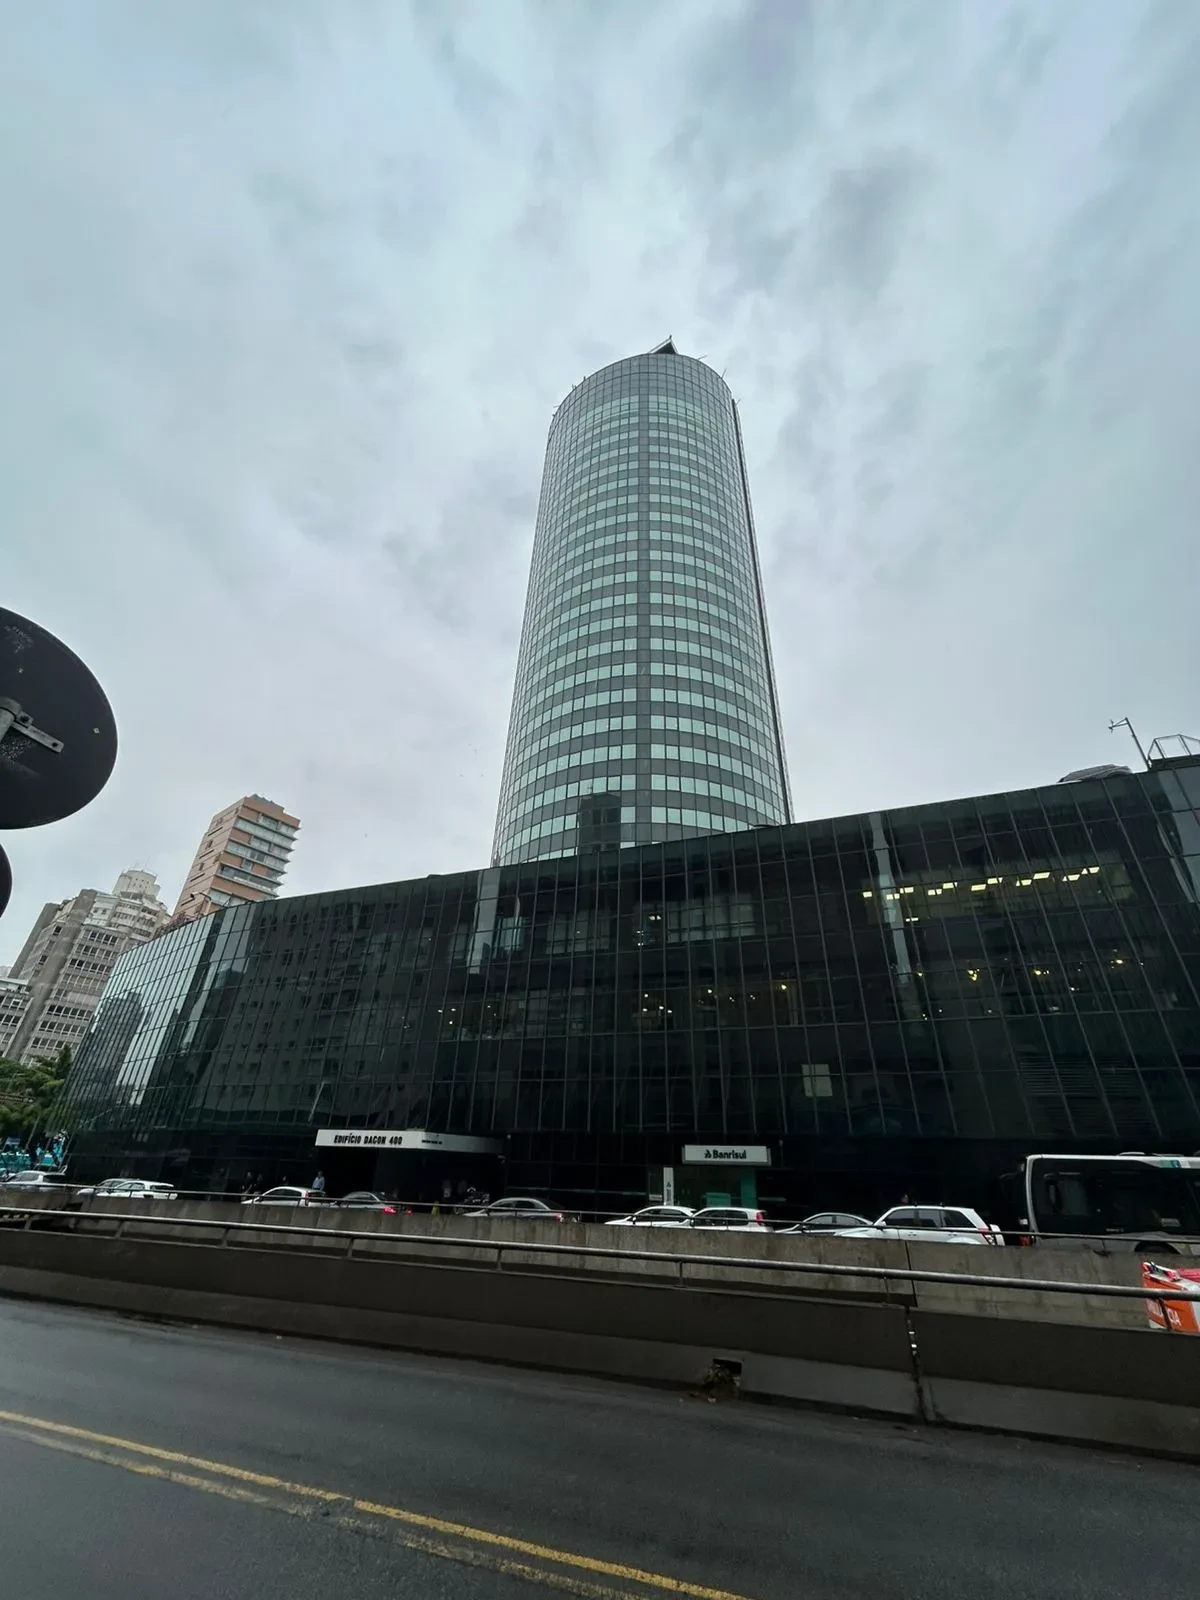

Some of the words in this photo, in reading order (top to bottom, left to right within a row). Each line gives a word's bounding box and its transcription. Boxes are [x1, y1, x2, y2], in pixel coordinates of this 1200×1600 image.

[334, 1133, 361, 1144] EDIFÍCIO
[364, 1136, 386, 1145] DACON
[389, 1136, 402, 1145] 400
[713, 1149, 746, 1159] Banrisul
